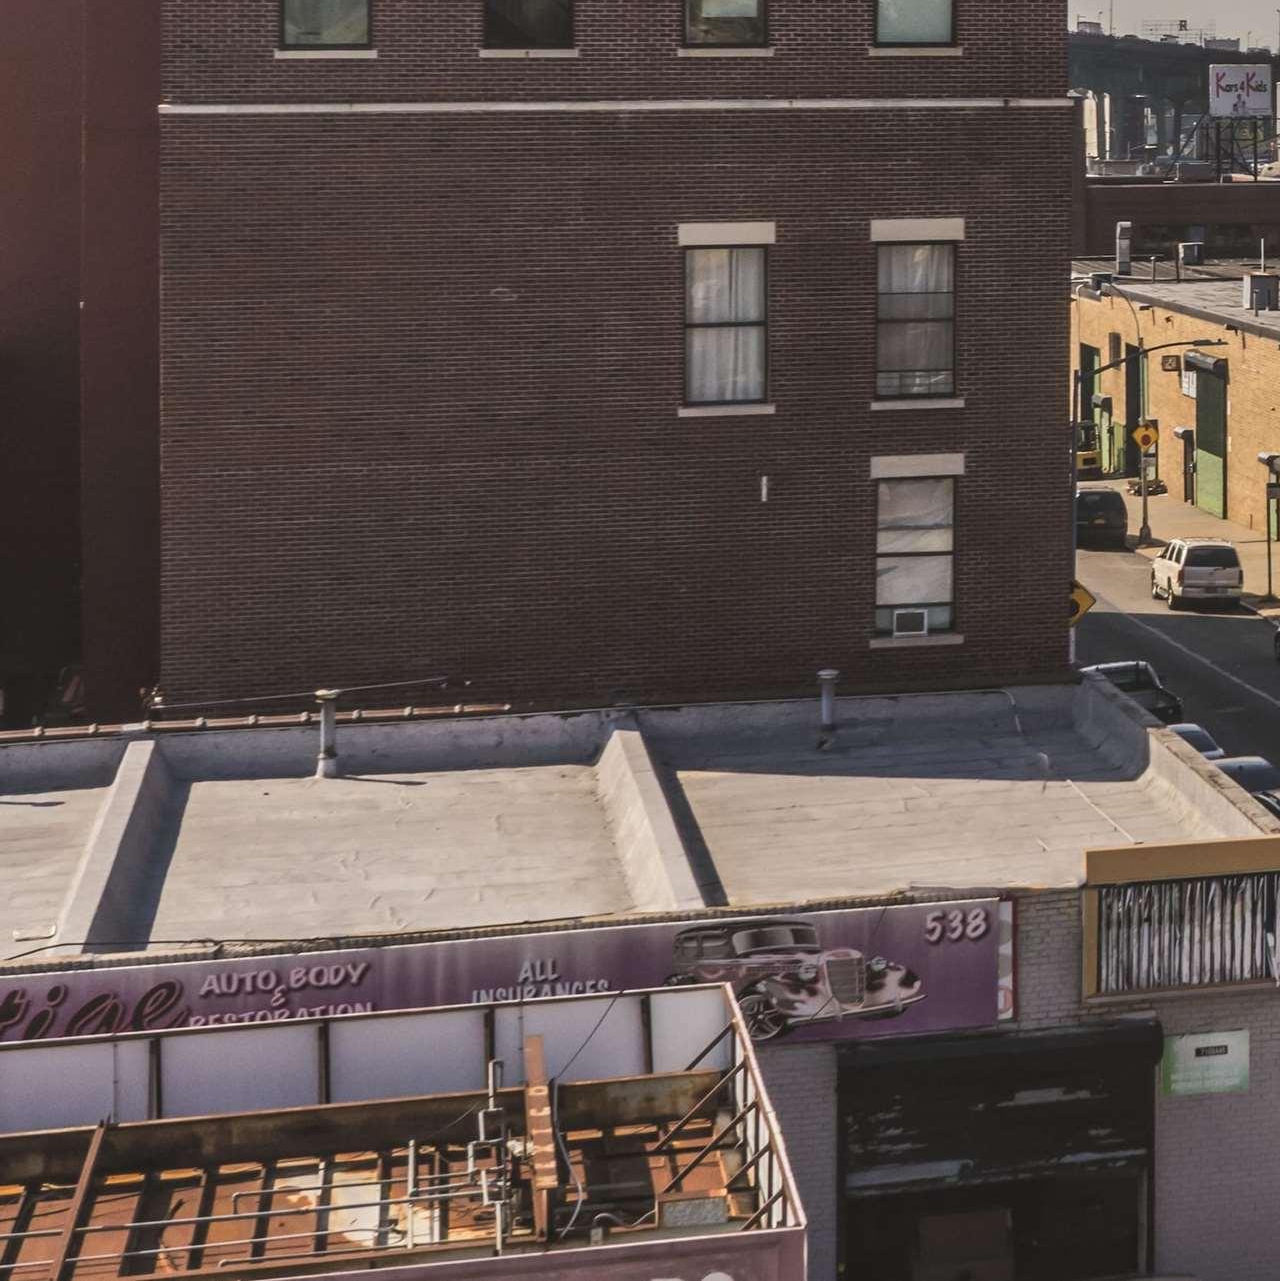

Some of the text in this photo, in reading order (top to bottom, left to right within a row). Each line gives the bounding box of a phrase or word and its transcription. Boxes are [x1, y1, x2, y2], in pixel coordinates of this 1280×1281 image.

[922, 908, 989, 945] 538
[200, 962, 367, 997] AUTO BODY
[518, 959, 559, 982] ALL
